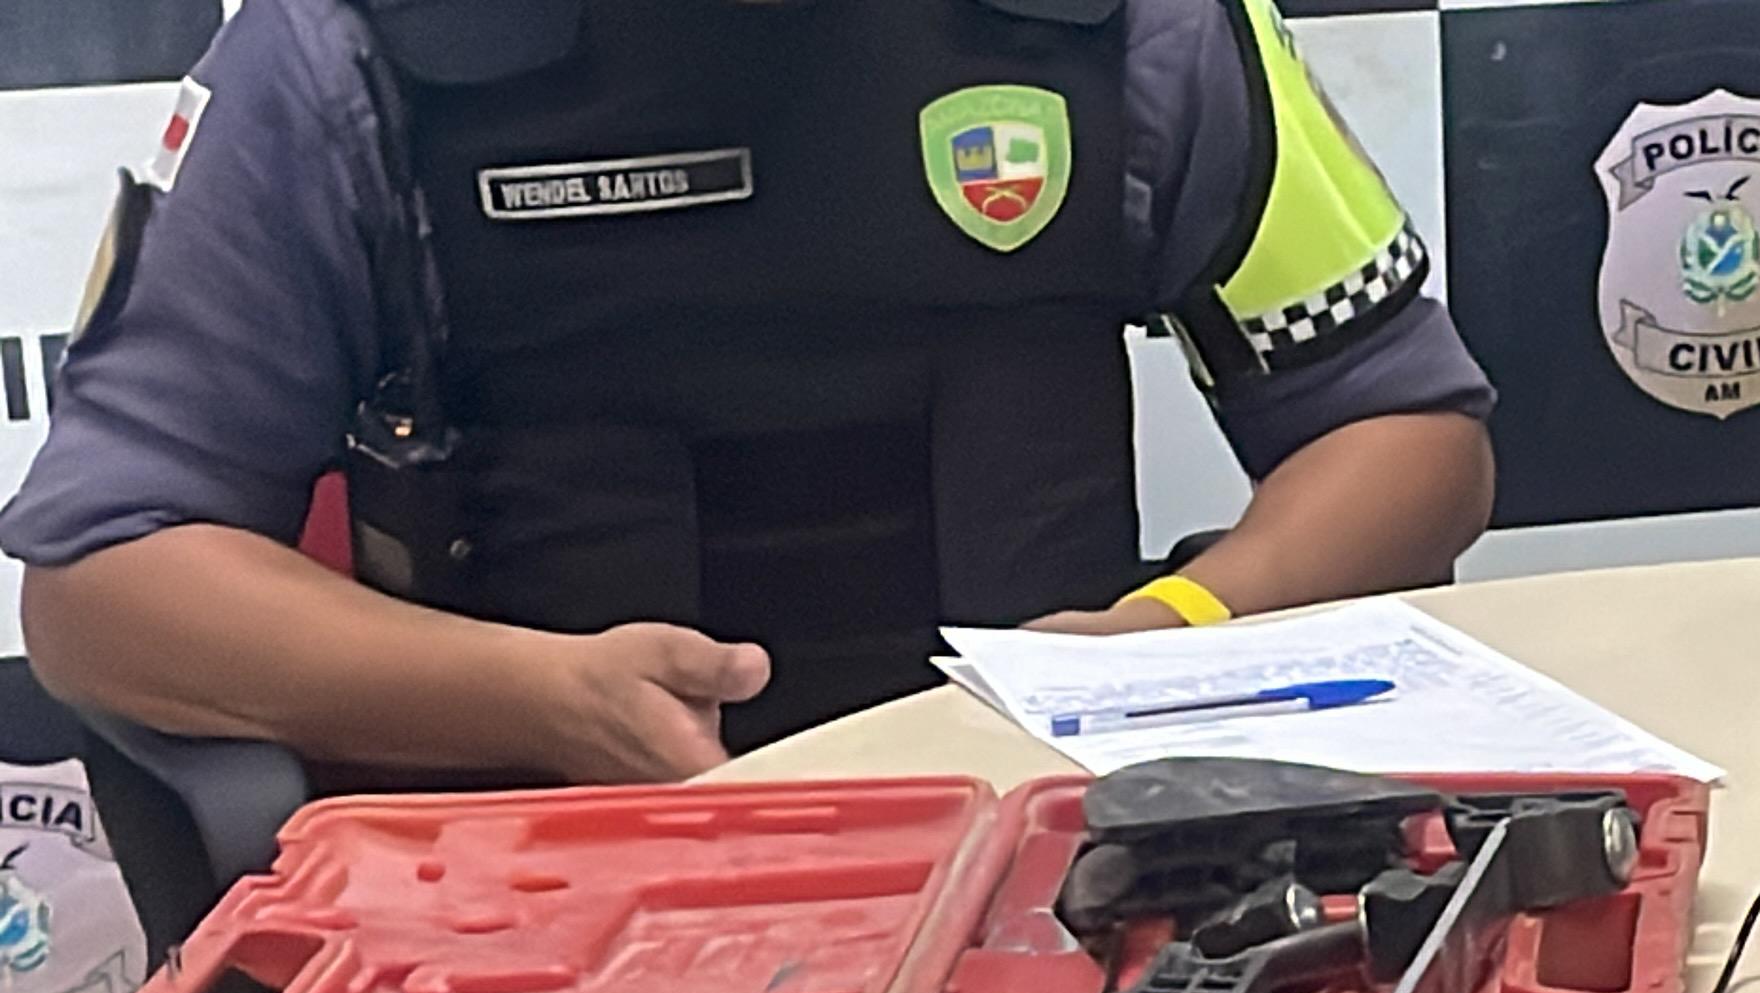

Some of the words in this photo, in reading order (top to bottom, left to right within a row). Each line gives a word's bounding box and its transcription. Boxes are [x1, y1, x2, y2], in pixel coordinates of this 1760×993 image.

[500, 177, 591, 208] WENDEL
[597, 169, 689, 200] SANTOS
[1704, 382, 1741, 401] AM
[0, 793, 82, 832] CIA
